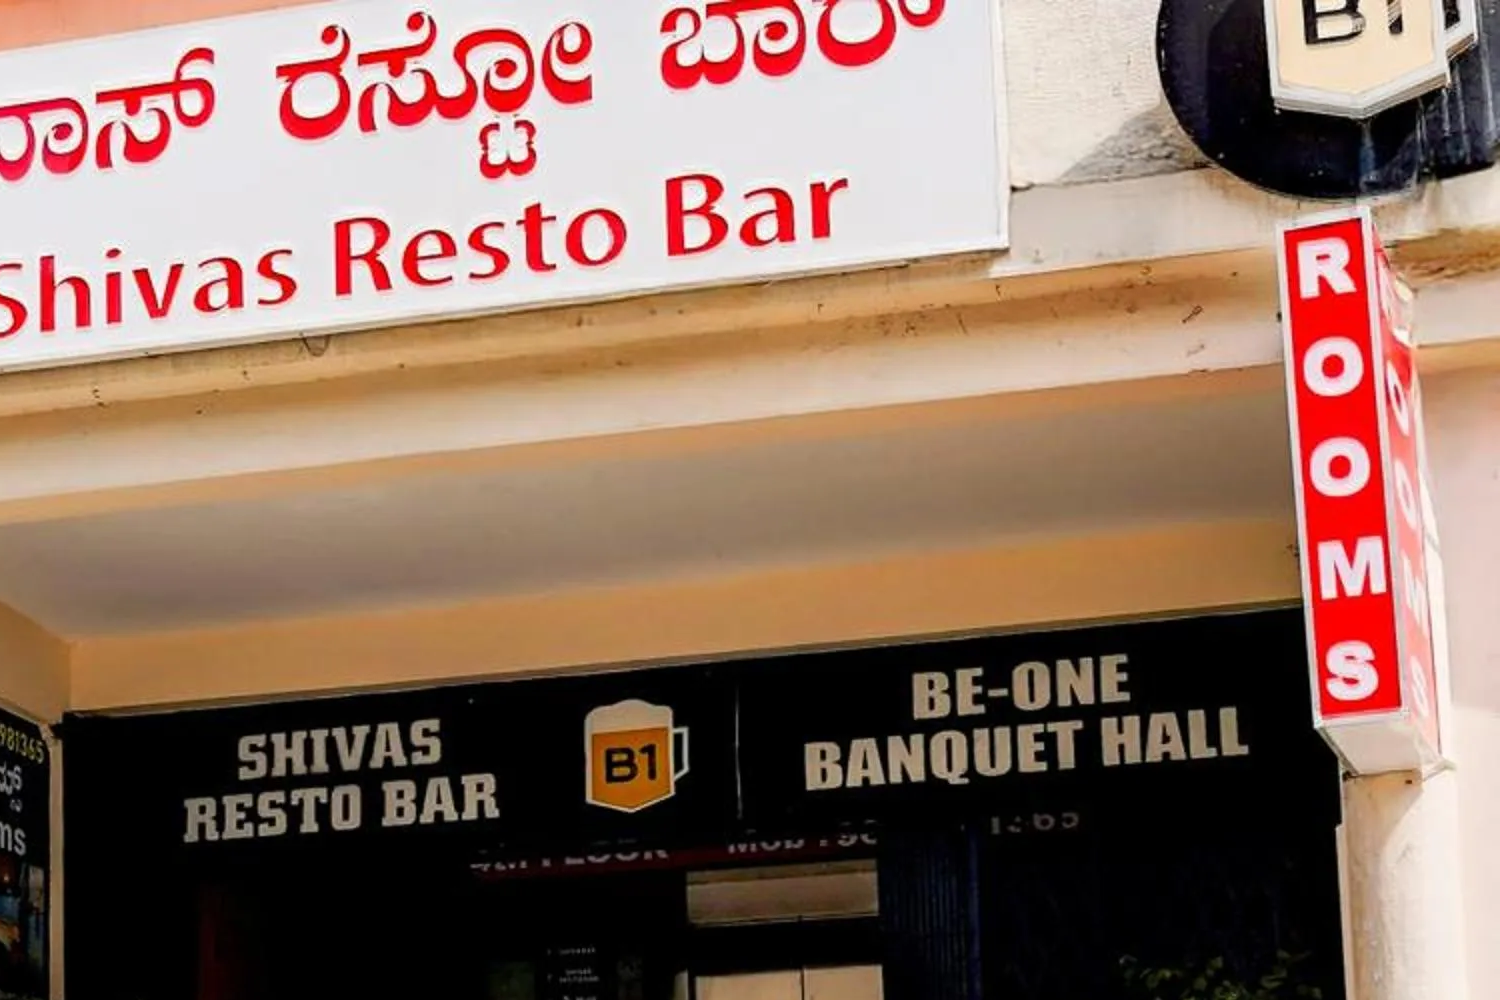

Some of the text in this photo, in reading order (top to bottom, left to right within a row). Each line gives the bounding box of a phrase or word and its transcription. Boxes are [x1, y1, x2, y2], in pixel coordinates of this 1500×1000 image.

[334, 203, 627, 297] Resto
[665, 173, 848, 257] Bar
[1296, 235, 1388, 702] ROOMS
[912, 653, 1131, 721] BE-ONE
[237, 718, 442, 781] SHIVAS
[604, 743, 657, 785] B1
[804, 706, 1249, 791] BANQUET HALL
[183, 772, 500, 844] RESTO BAR
